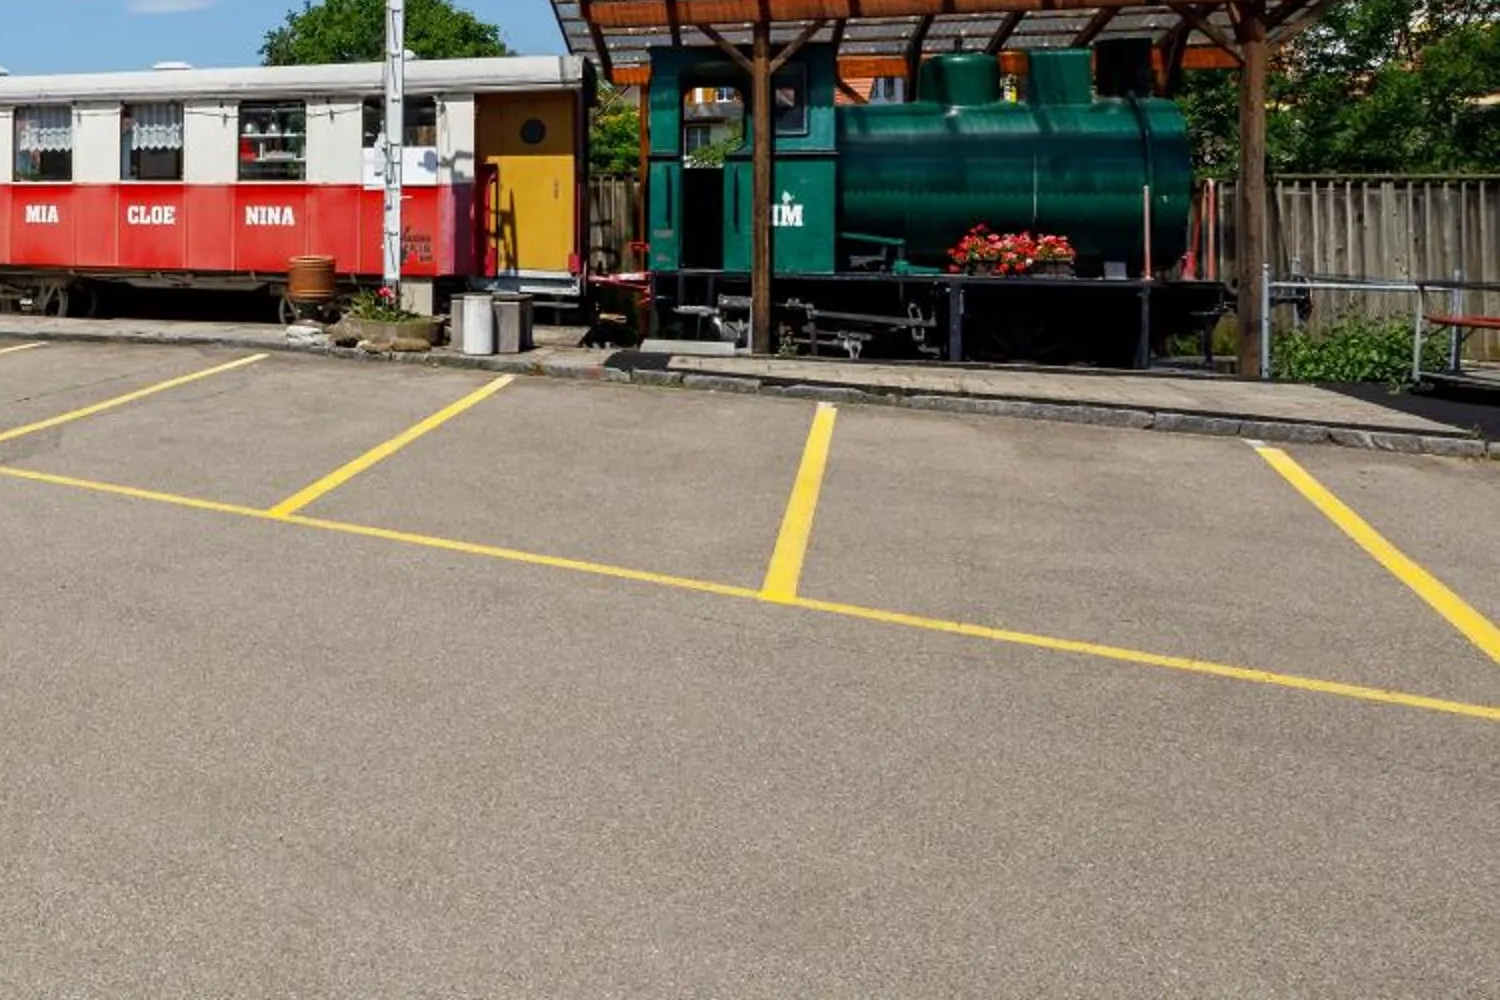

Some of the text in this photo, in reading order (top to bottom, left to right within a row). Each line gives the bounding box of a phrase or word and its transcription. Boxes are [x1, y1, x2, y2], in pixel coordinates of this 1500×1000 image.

[25, 205, 60, 223] MIA
[127, 205, 176, 225] CLOE
[245, 206, 295, 226] NINA
